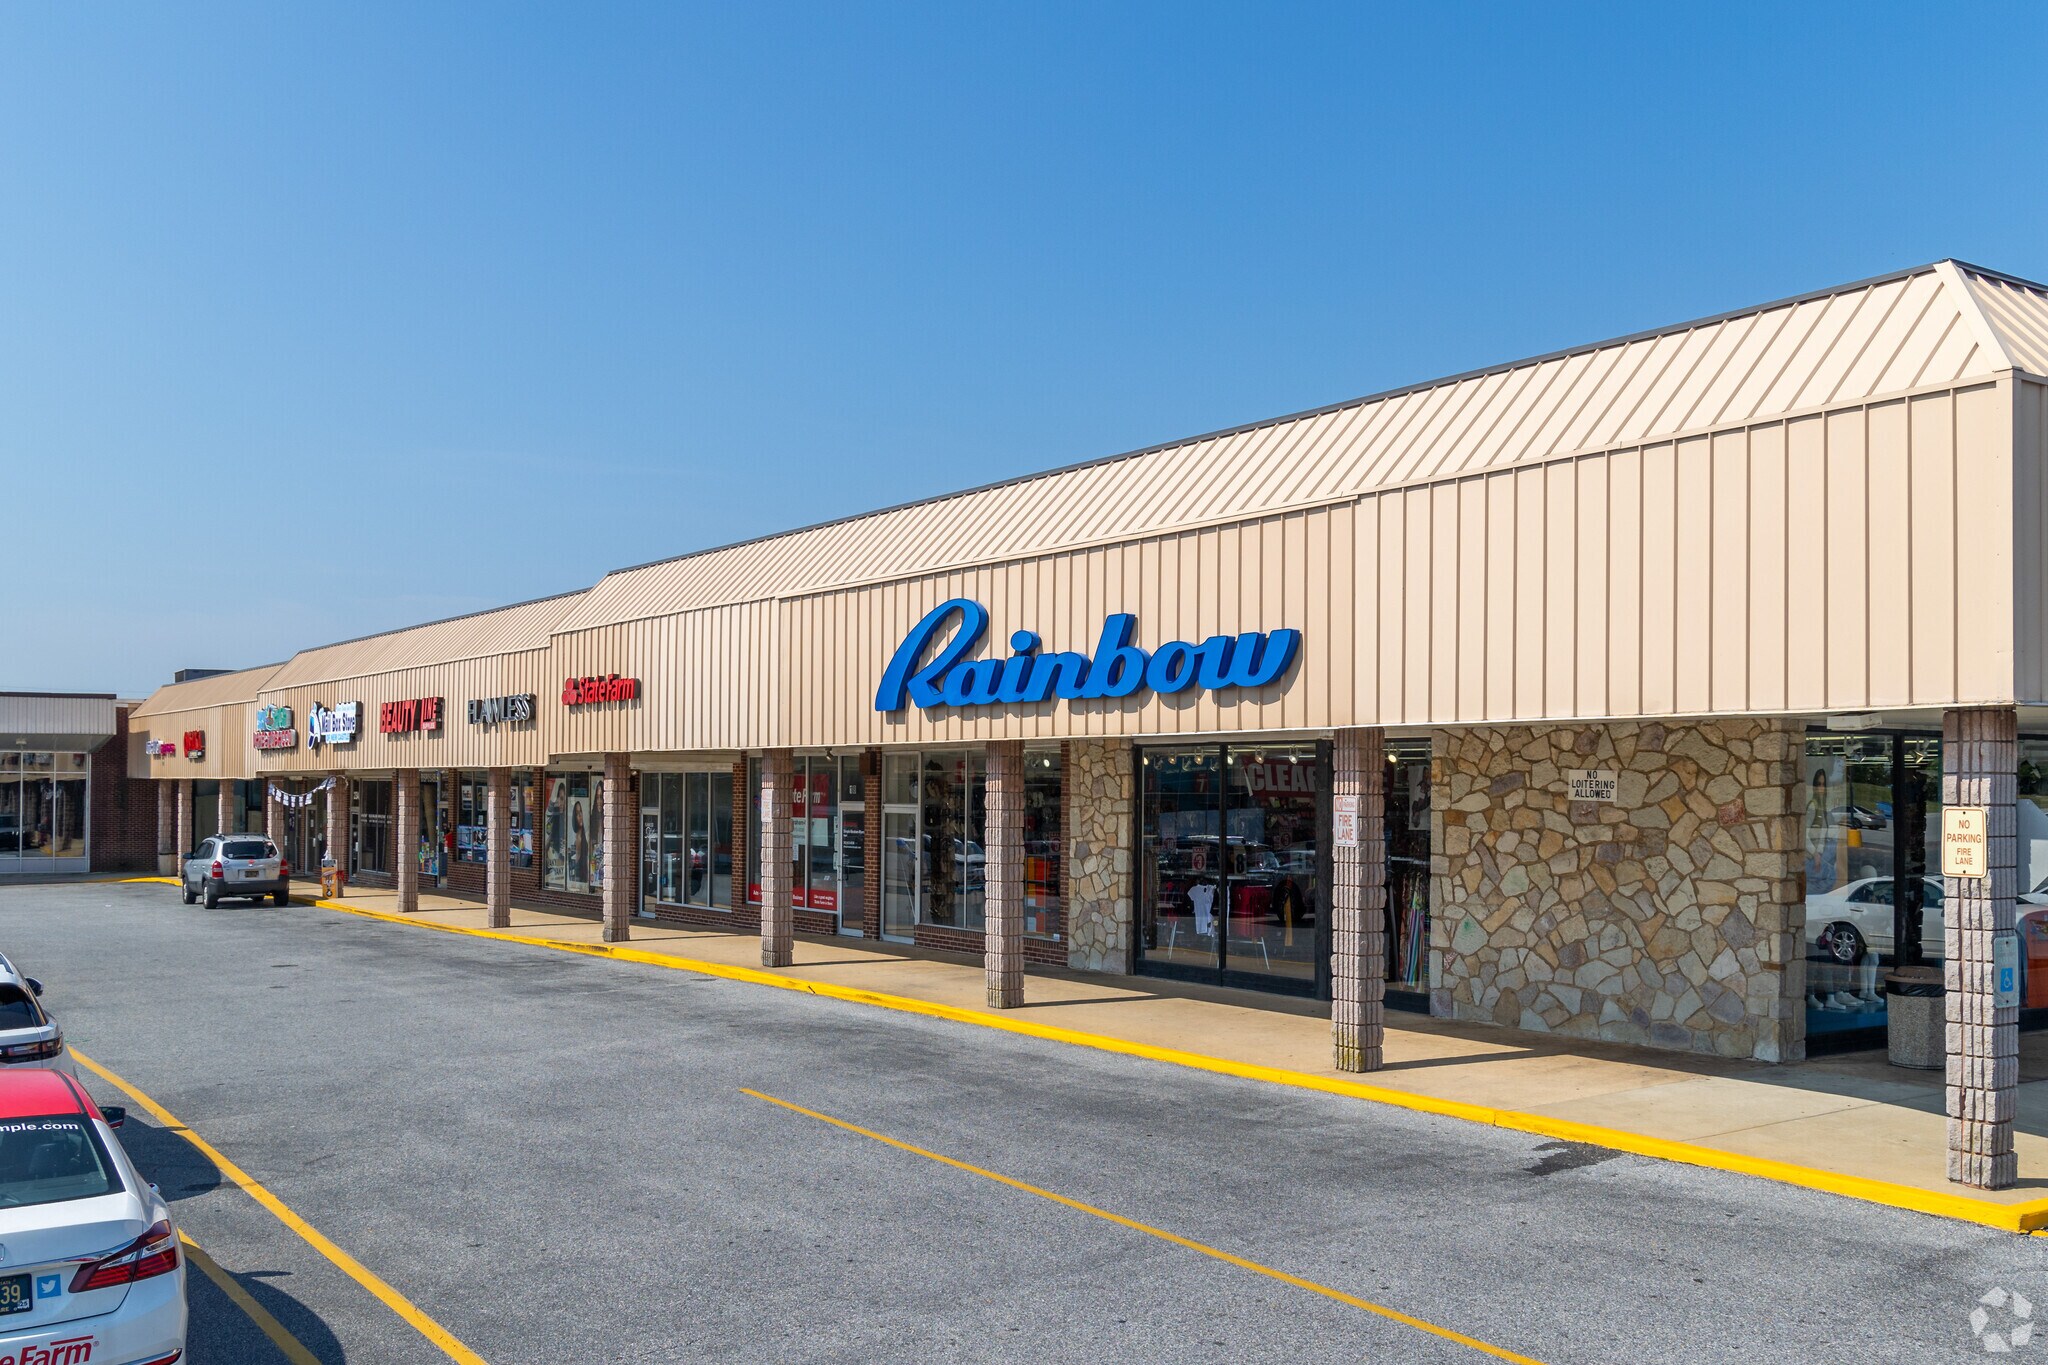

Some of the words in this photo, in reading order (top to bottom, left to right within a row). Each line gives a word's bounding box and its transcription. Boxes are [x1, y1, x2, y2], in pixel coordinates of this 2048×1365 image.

[875, 597, 1301, 712] Rainbow
[468, 692, 531, 725] FLAWLESS
[380, 699, 417, 733] BEAUTY
[332, 713, 341, 732] Box
[342, 712, 356, 731] Store
[1587, 770, 1598, 779] NO
[1571, 779, 1615, 789] LOITERING
[1575, 789, 1611, 798] ALLOWED
[1338, 814, 1352, 827] FIRE
[1958, 819, 1970, 829] NO
[1337, 828, 1353, 840] LANE
[1946, 833, 1982, 843] PARKING
[1957, 848, 1972, 856] FIRE
[1955, 857, 1973, 865] LANE
